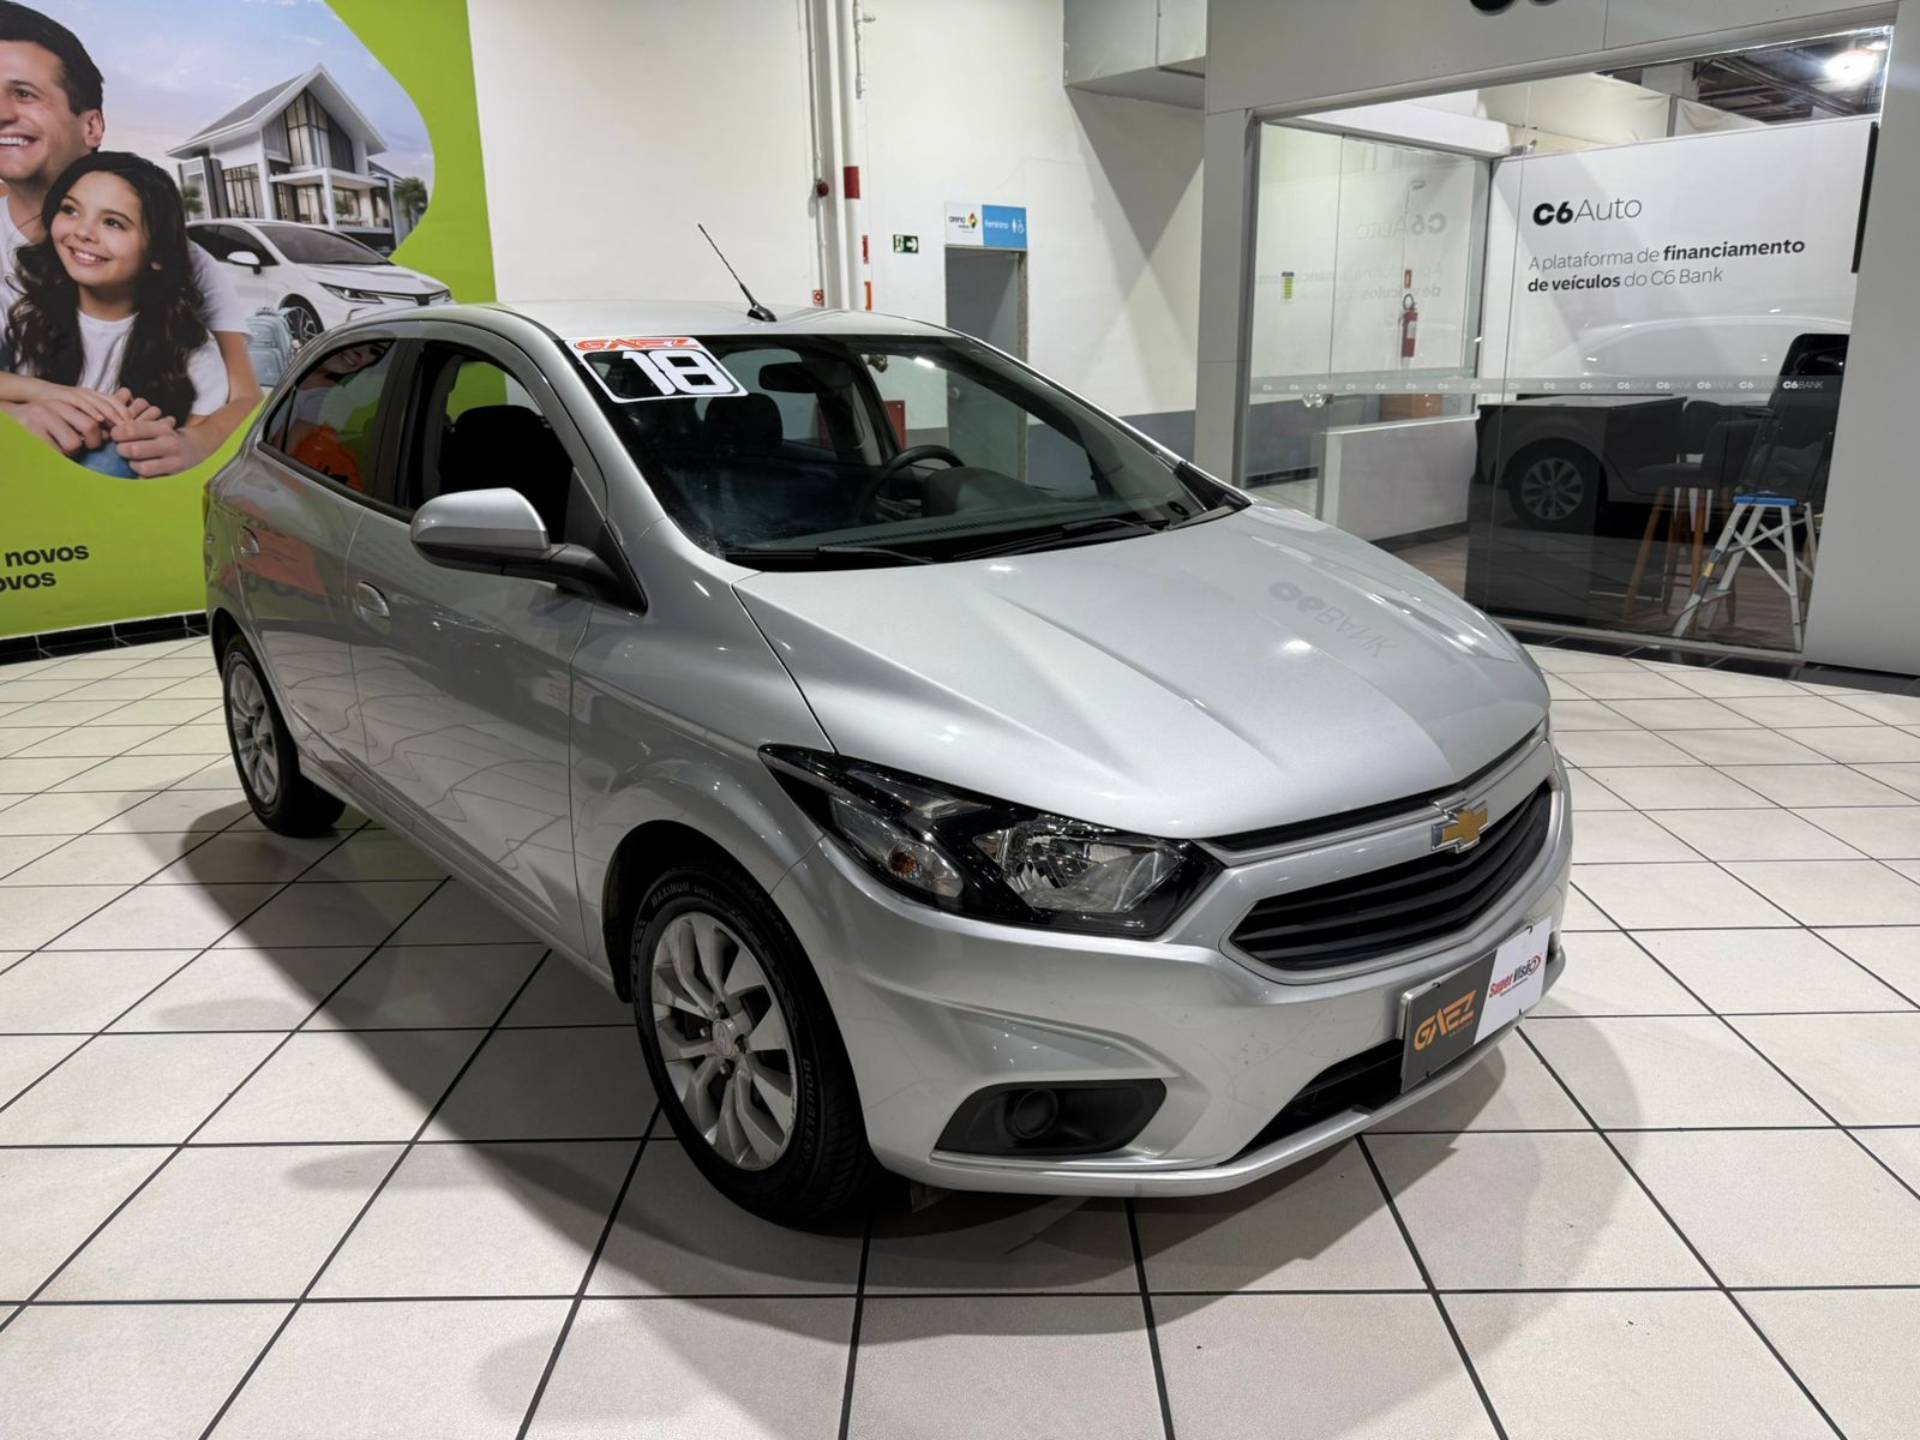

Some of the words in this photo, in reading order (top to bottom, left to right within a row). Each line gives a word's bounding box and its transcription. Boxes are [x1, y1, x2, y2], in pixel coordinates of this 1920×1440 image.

[1533, 198, 1642, 226] C6Auto
[1529, 256, 1540, 271] A
[1542, 251, 1633, 273] plataforma
[1637, 248, 1660, 263] de
[1663, 239, 1805, 261] financiamento
[1527, 278, 1549, 292] de
[1552, 274, 1621, 291] veículos
[1624, 272, 1648, 287] do
[1651, 269, 1676, 286] C6
[1679, 266, 1723, 284] Bank
[622, 350, 736, 396] 18
[5, 545, 90, 567] novos
[1414, 989, 1476, 1051] GAEZ
